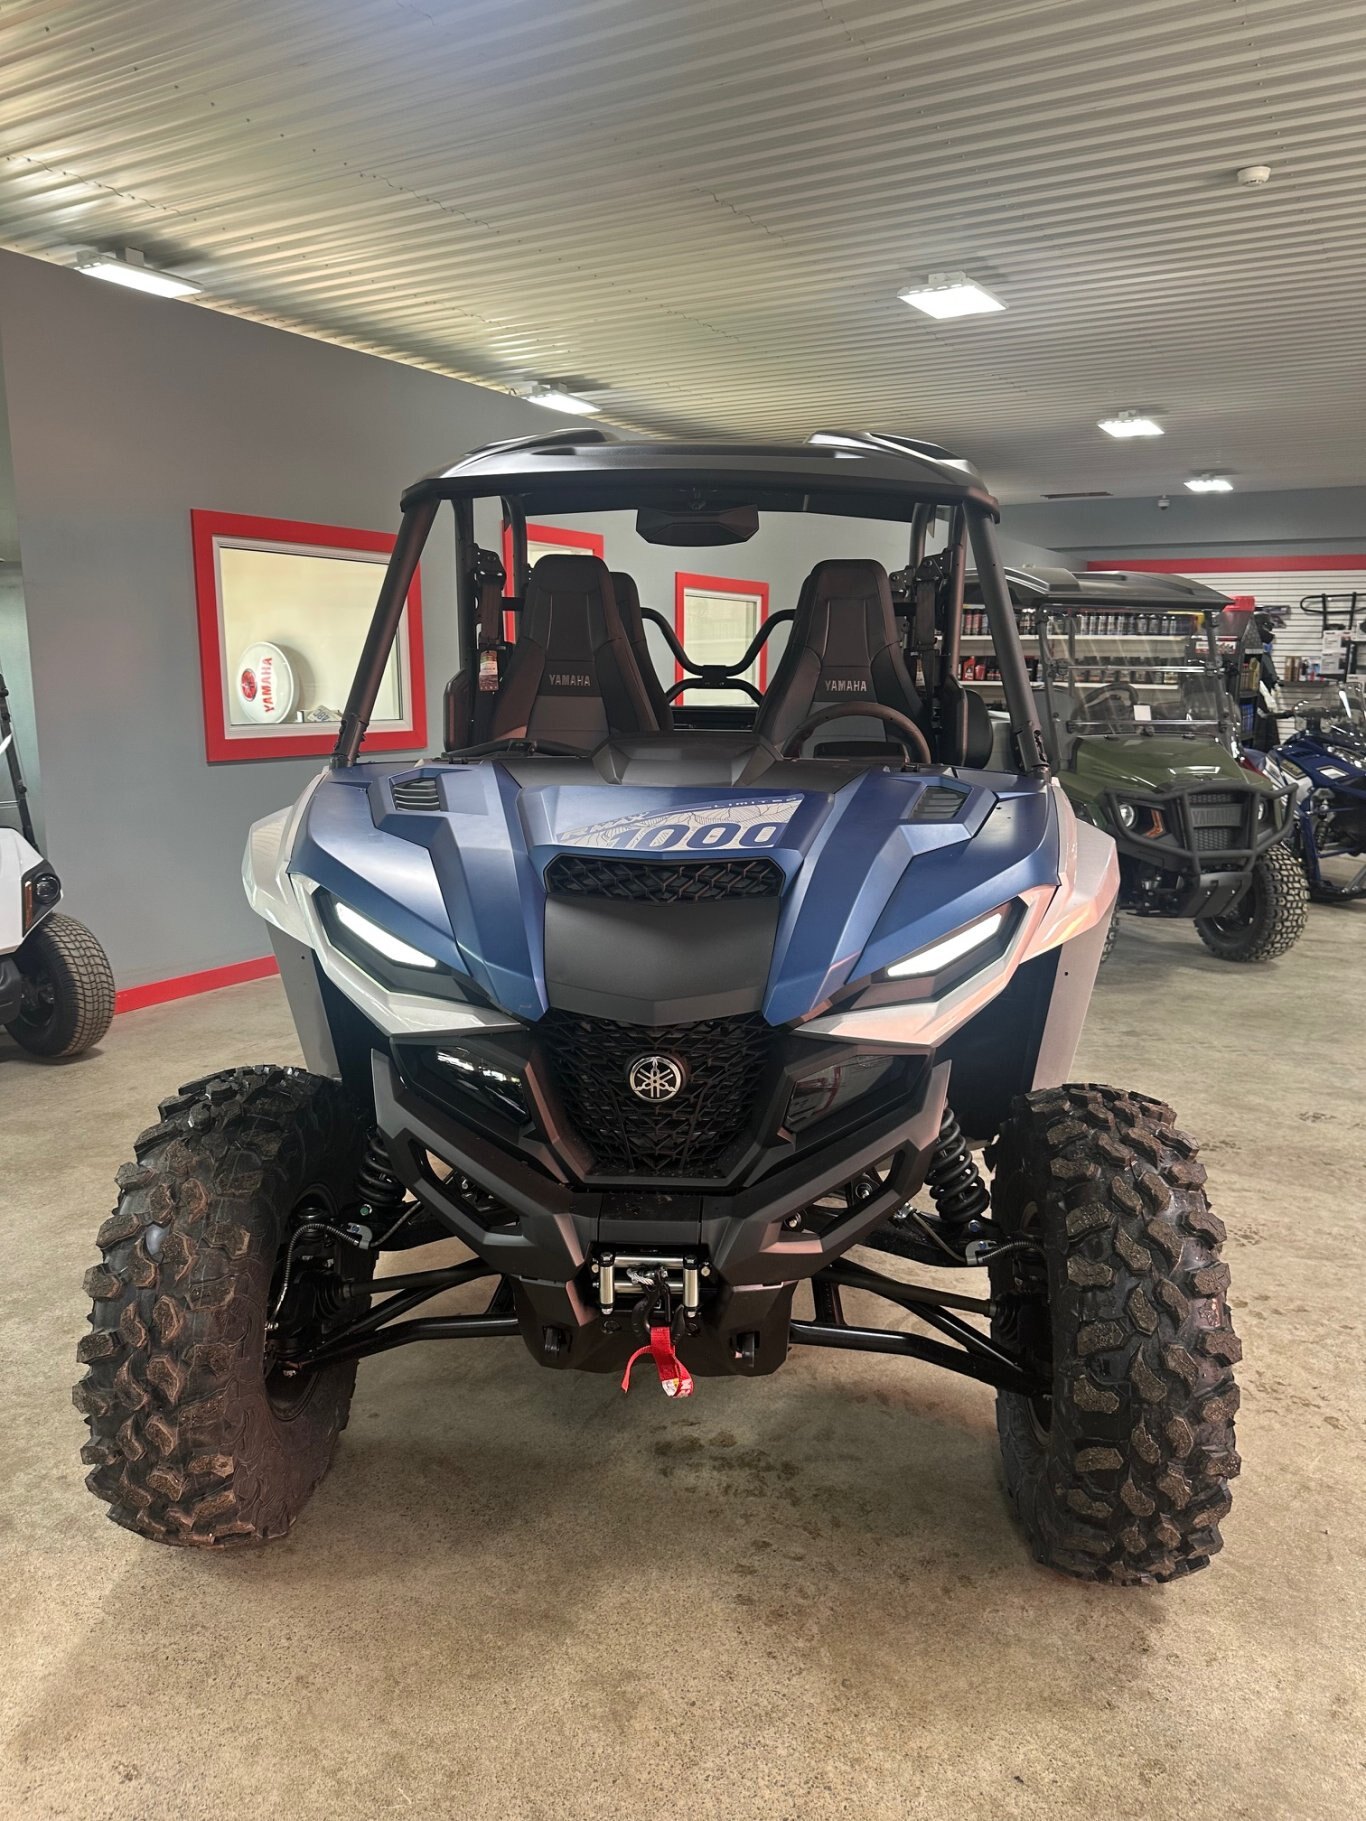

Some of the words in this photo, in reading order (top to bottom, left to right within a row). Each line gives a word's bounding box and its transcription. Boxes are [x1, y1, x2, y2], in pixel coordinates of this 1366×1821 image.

[261, 657, 275, 713] YAMAHA
[549, 673, 591, 687] YAMAHA
[824, 679, 868, 692] YAMAHA
[612, 821, 788, 850] 1000
